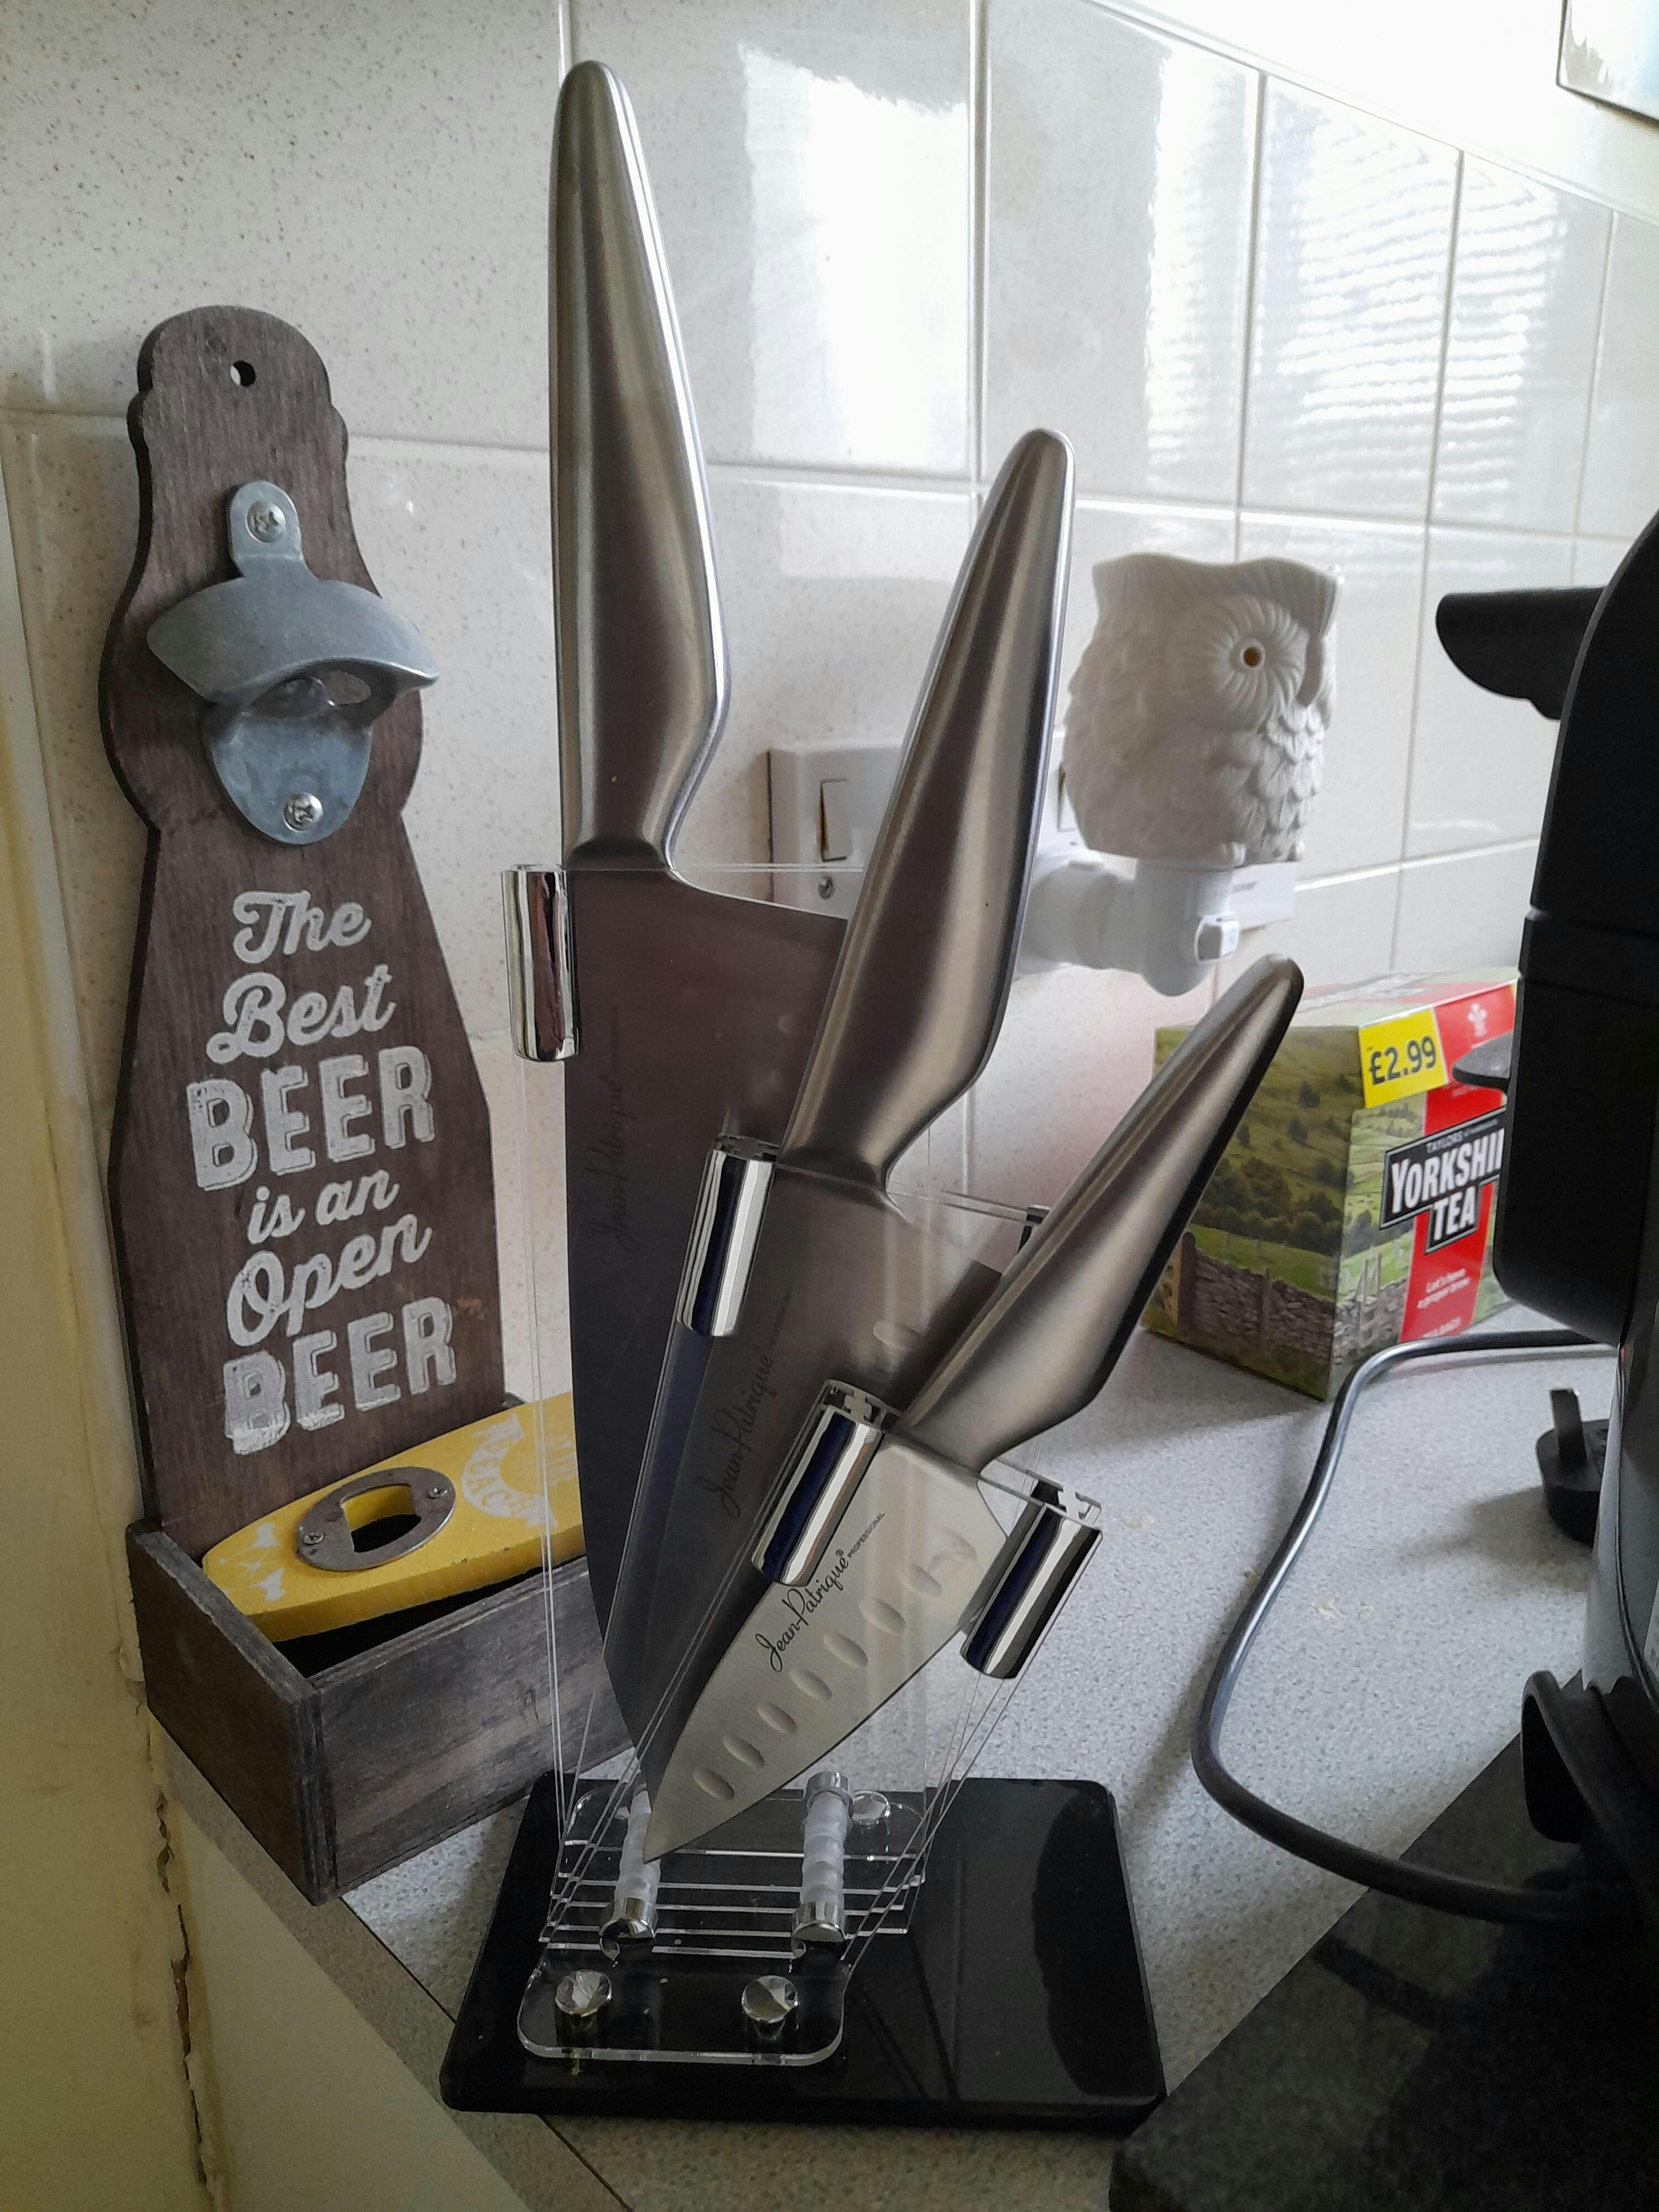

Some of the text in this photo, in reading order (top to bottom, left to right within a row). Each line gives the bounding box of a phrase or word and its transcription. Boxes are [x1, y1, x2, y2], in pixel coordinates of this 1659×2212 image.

[233, 890, 372, 964] The
[206, 963, 397, 1064] Best
[1368, 1035, 1436, 1086] £2.99
[186, 1045, 435, 1191] BEER
[247, 1168, 399, 1244] is an
[1433, 1186, 1477, 1241] TEA
[226, 1213, 433, 1348] Open
[222, 1295, 457, 1455] BEER
[695, 1354, 778, 1519] Jean-Patrique
[755, 1557, 849, 1673] Jean-Patrique
